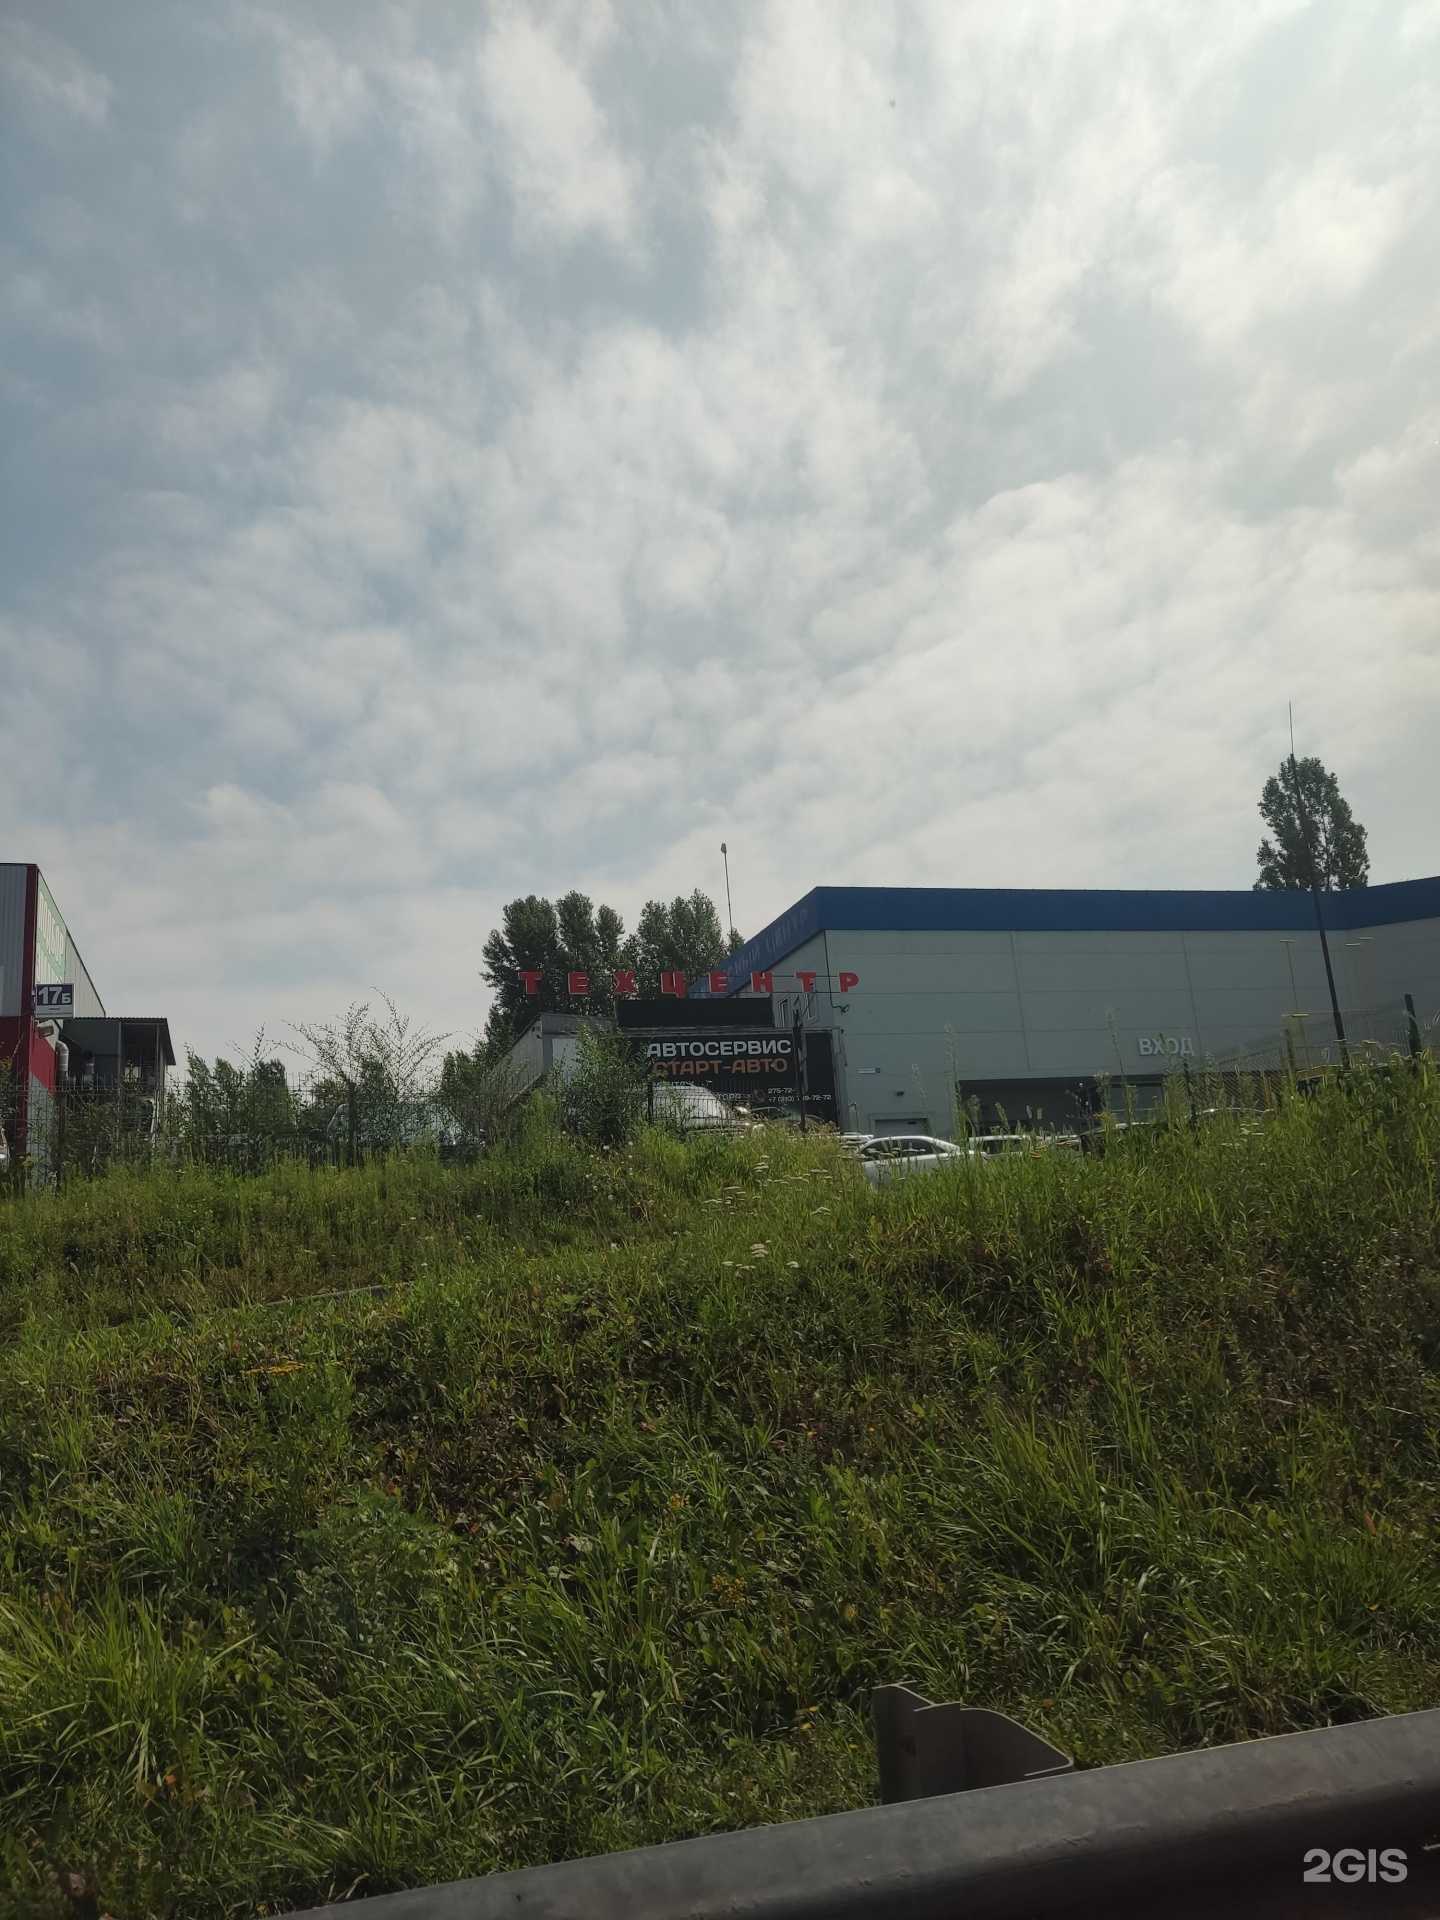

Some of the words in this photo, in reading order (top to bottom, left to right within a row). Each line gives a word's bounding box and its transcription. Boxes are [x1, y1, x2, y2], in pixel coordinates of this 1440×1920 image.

[518, 970, 861, 998] ТЕХЦЕНТР
[38, 986, 71, 1004] 17Б
[646, 1039, 792, 1057] АВТОСЕРВИС
[1138, 1038, 1194, 1056] ВХОД
[652, 1058, 788, 1075] СТАРТ-АВТО
